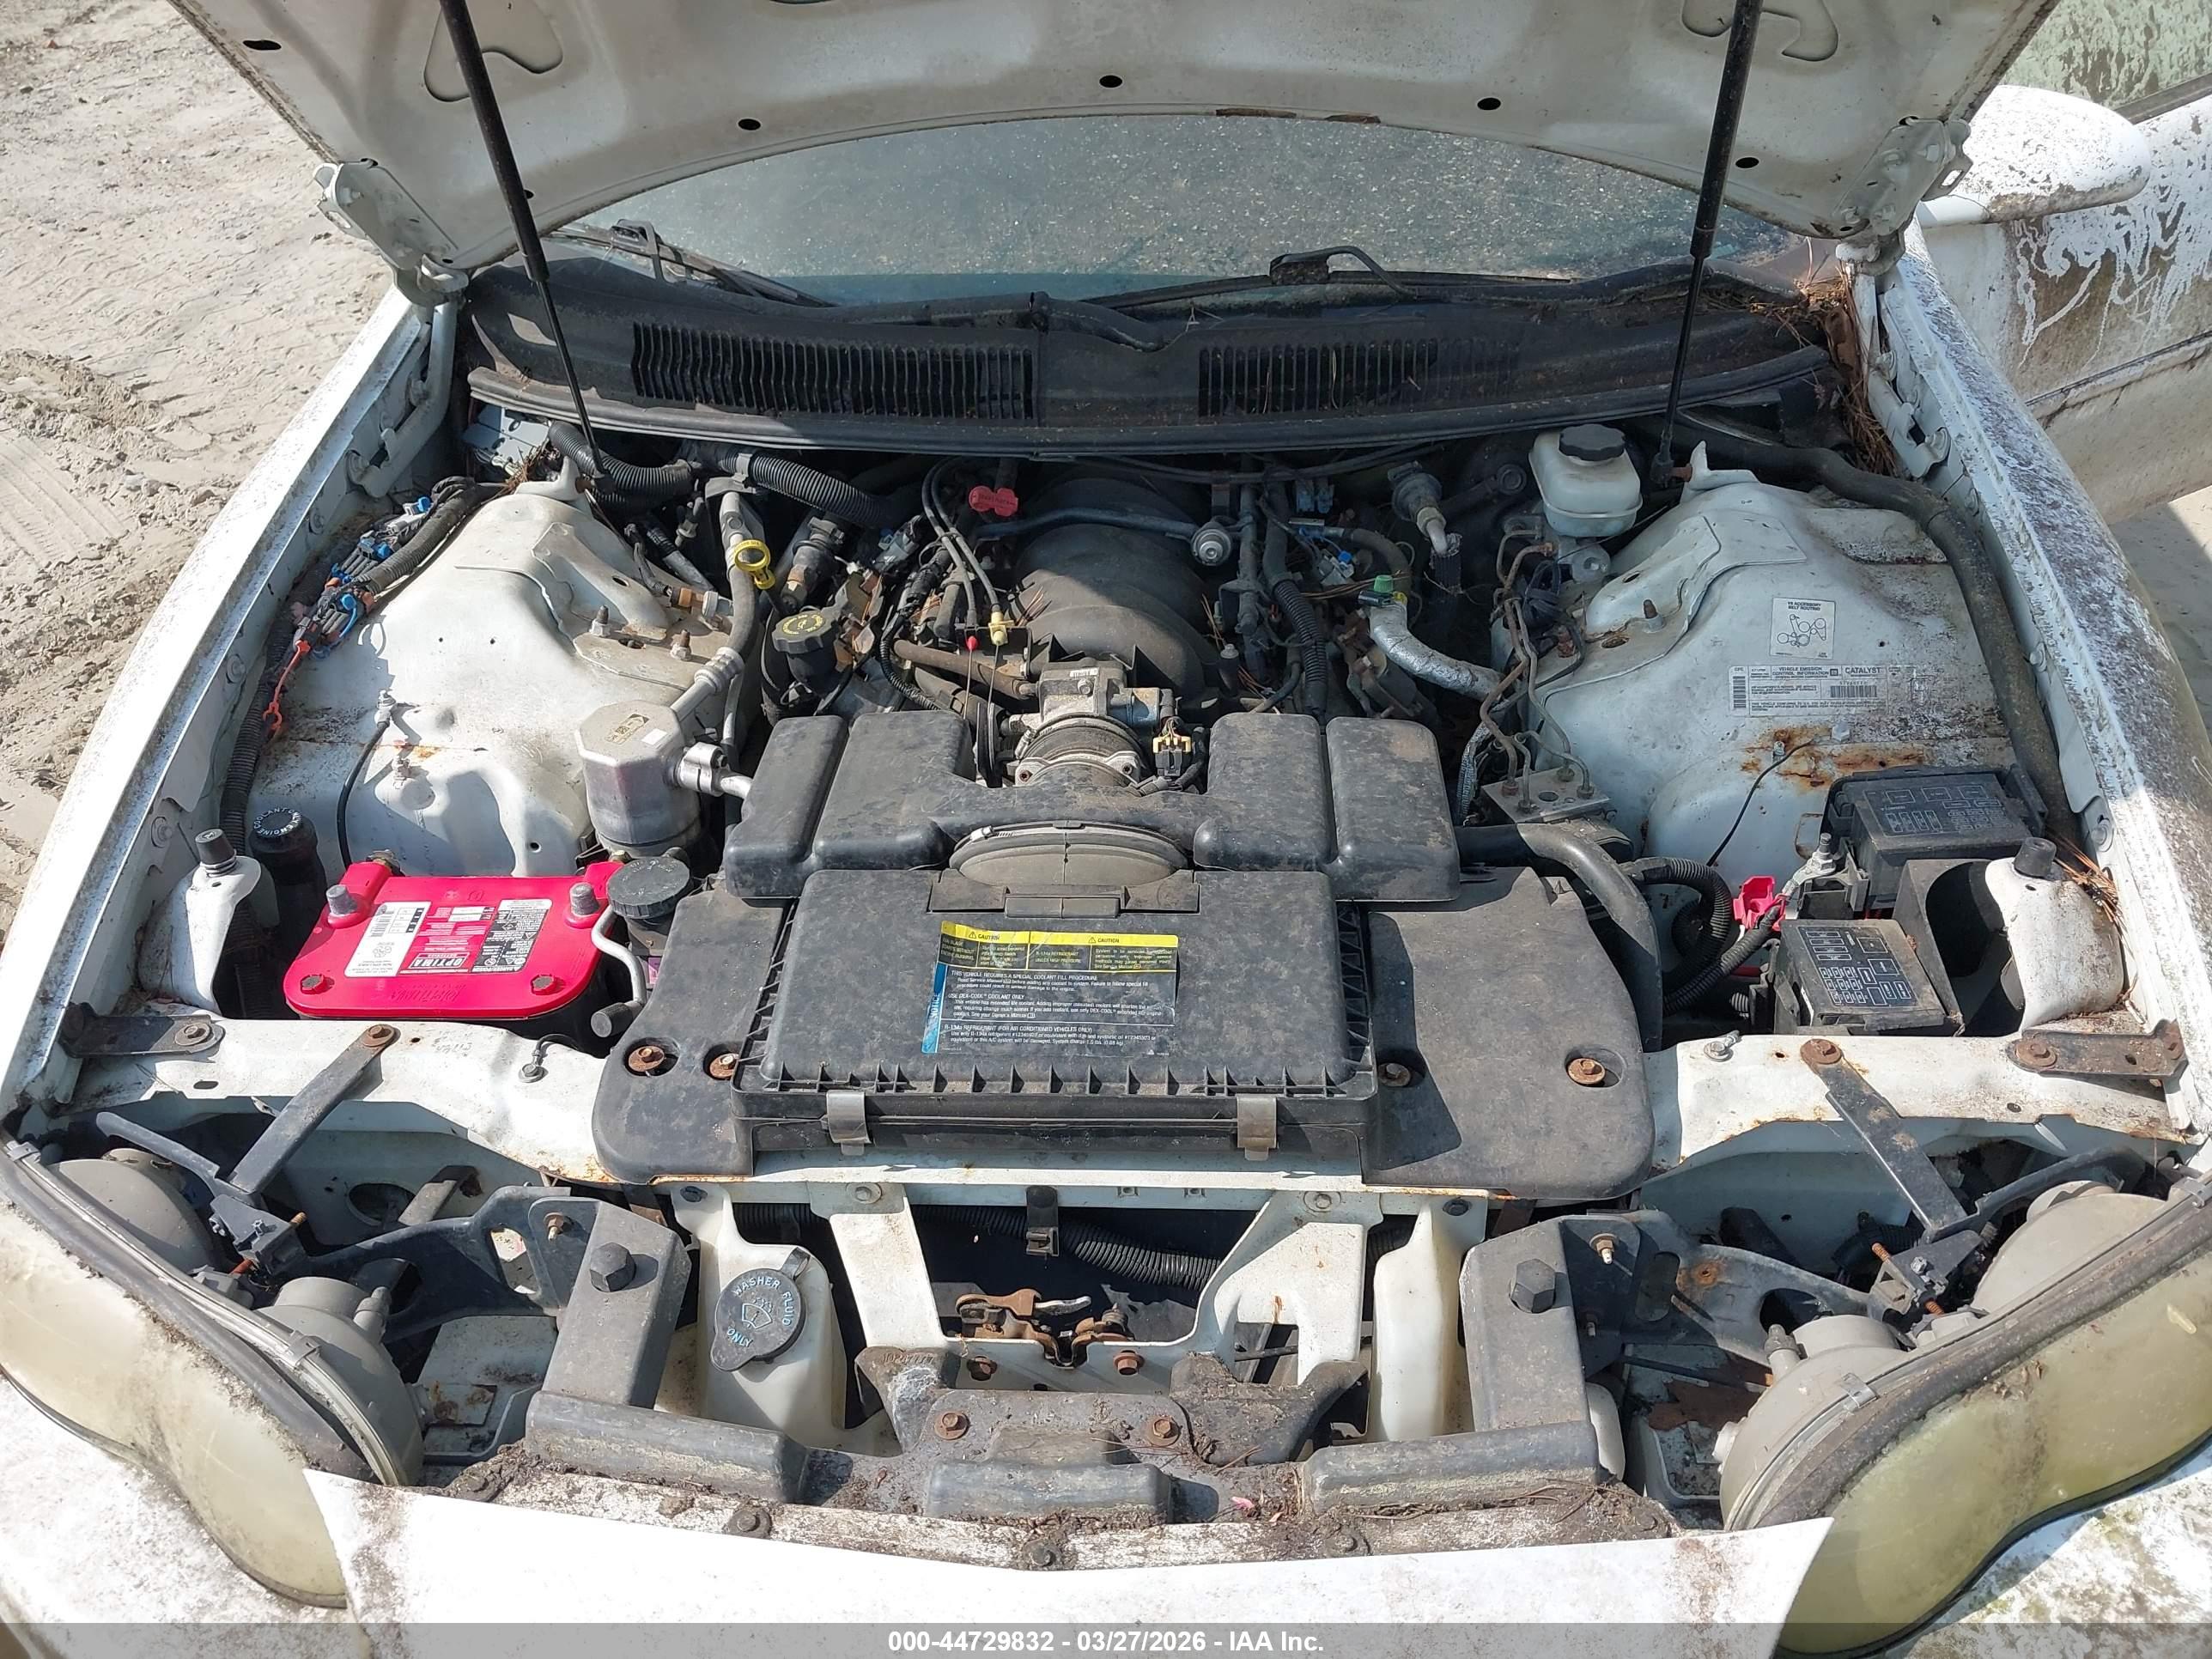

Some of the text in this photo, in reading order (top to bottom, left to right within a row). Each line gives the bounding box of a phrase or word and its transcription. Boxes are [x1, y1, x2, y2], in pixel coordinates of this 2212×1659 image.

[253, 807, 289, 830] COOLANT
[414, 957, 463, 967] OPTIMA
[929, 993, 939, 1018] NOTICE
[732, 1275, 794, 1327] WASHER FLUID
[726, 1327, 754, 1348] ONLY
